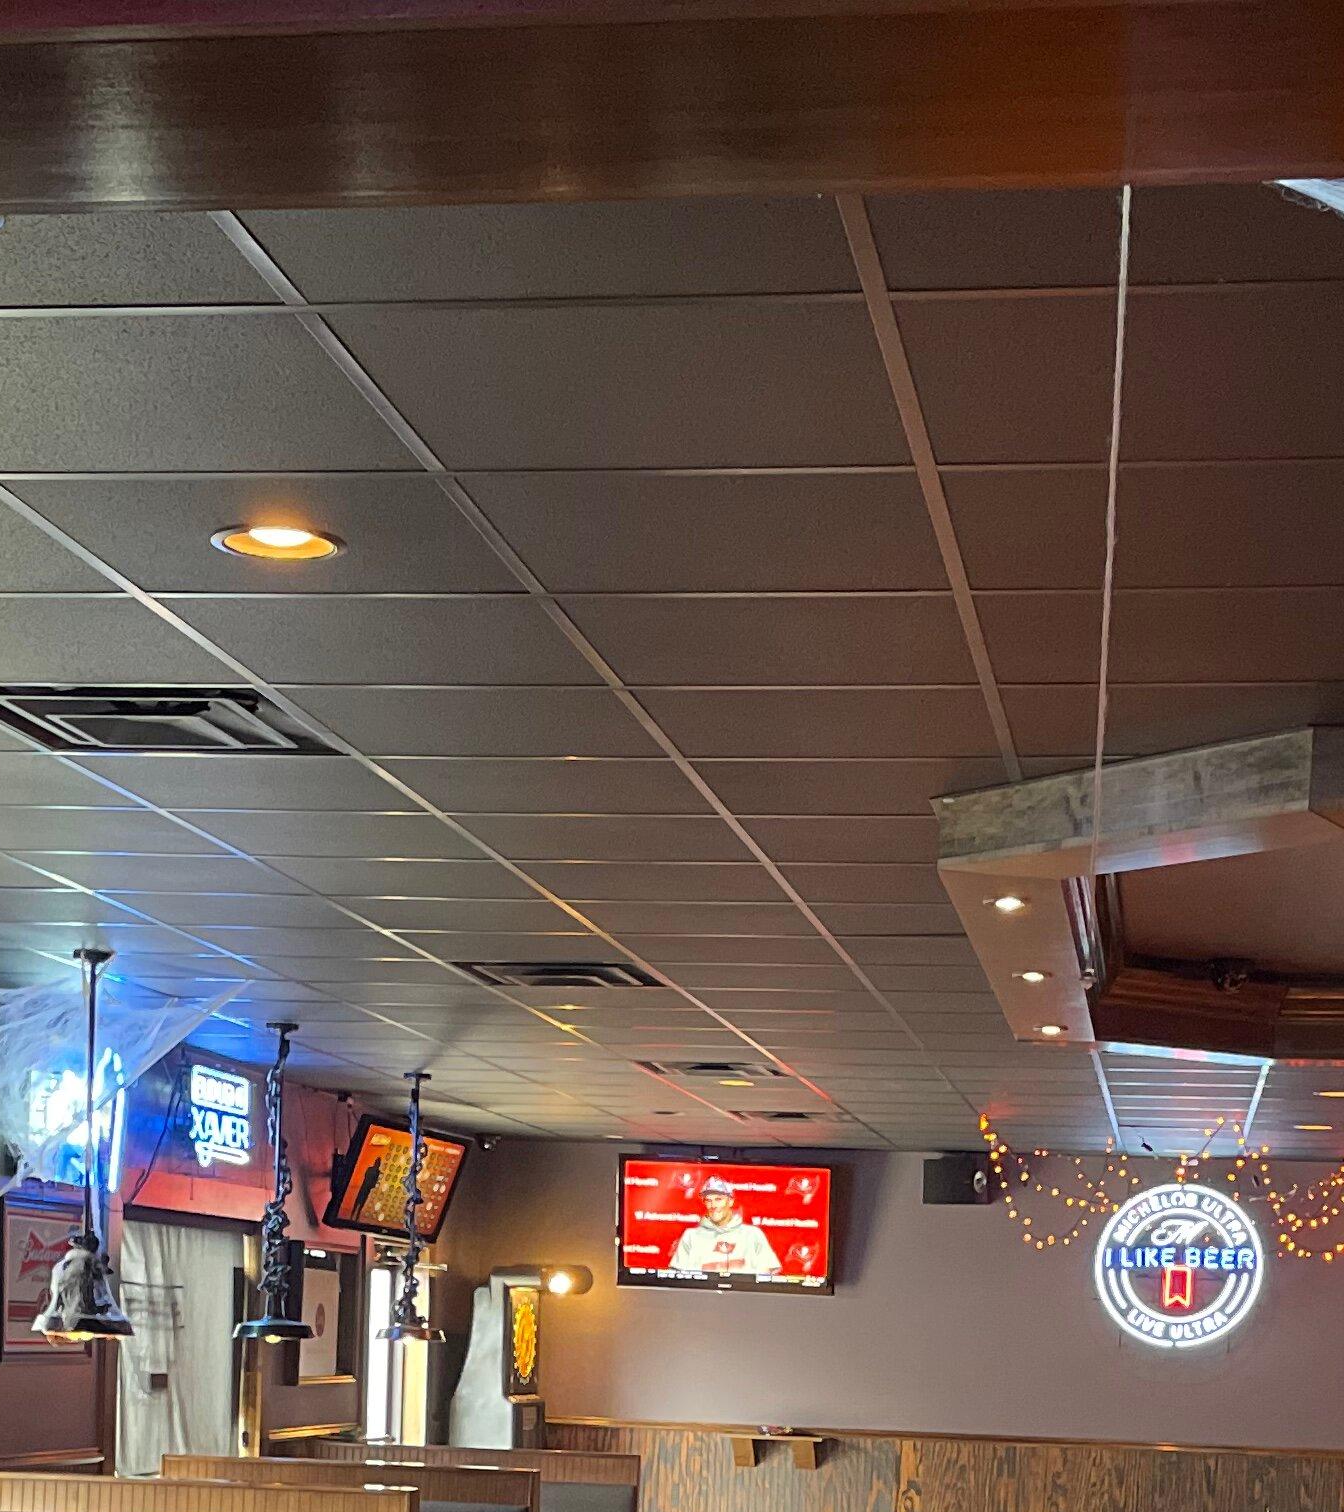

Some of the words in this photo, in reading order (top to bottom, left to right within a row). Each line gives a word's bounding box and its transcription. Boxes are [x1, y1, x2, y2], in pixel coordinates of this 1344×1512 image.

[1113, 1191, 1199, 1243] MICHELOB
[1200, 1196, 1248, 1246] ULTRA
[1105, 1247, 1112, 1268] I
[1120, 1247, 1177, 1269] LIKE
[1184, 1247, 1255, 1270] BEER
[1127, 1308, 1166, 1338] LIVE
[1169, 1311, 1228, 1340] ULTRA
